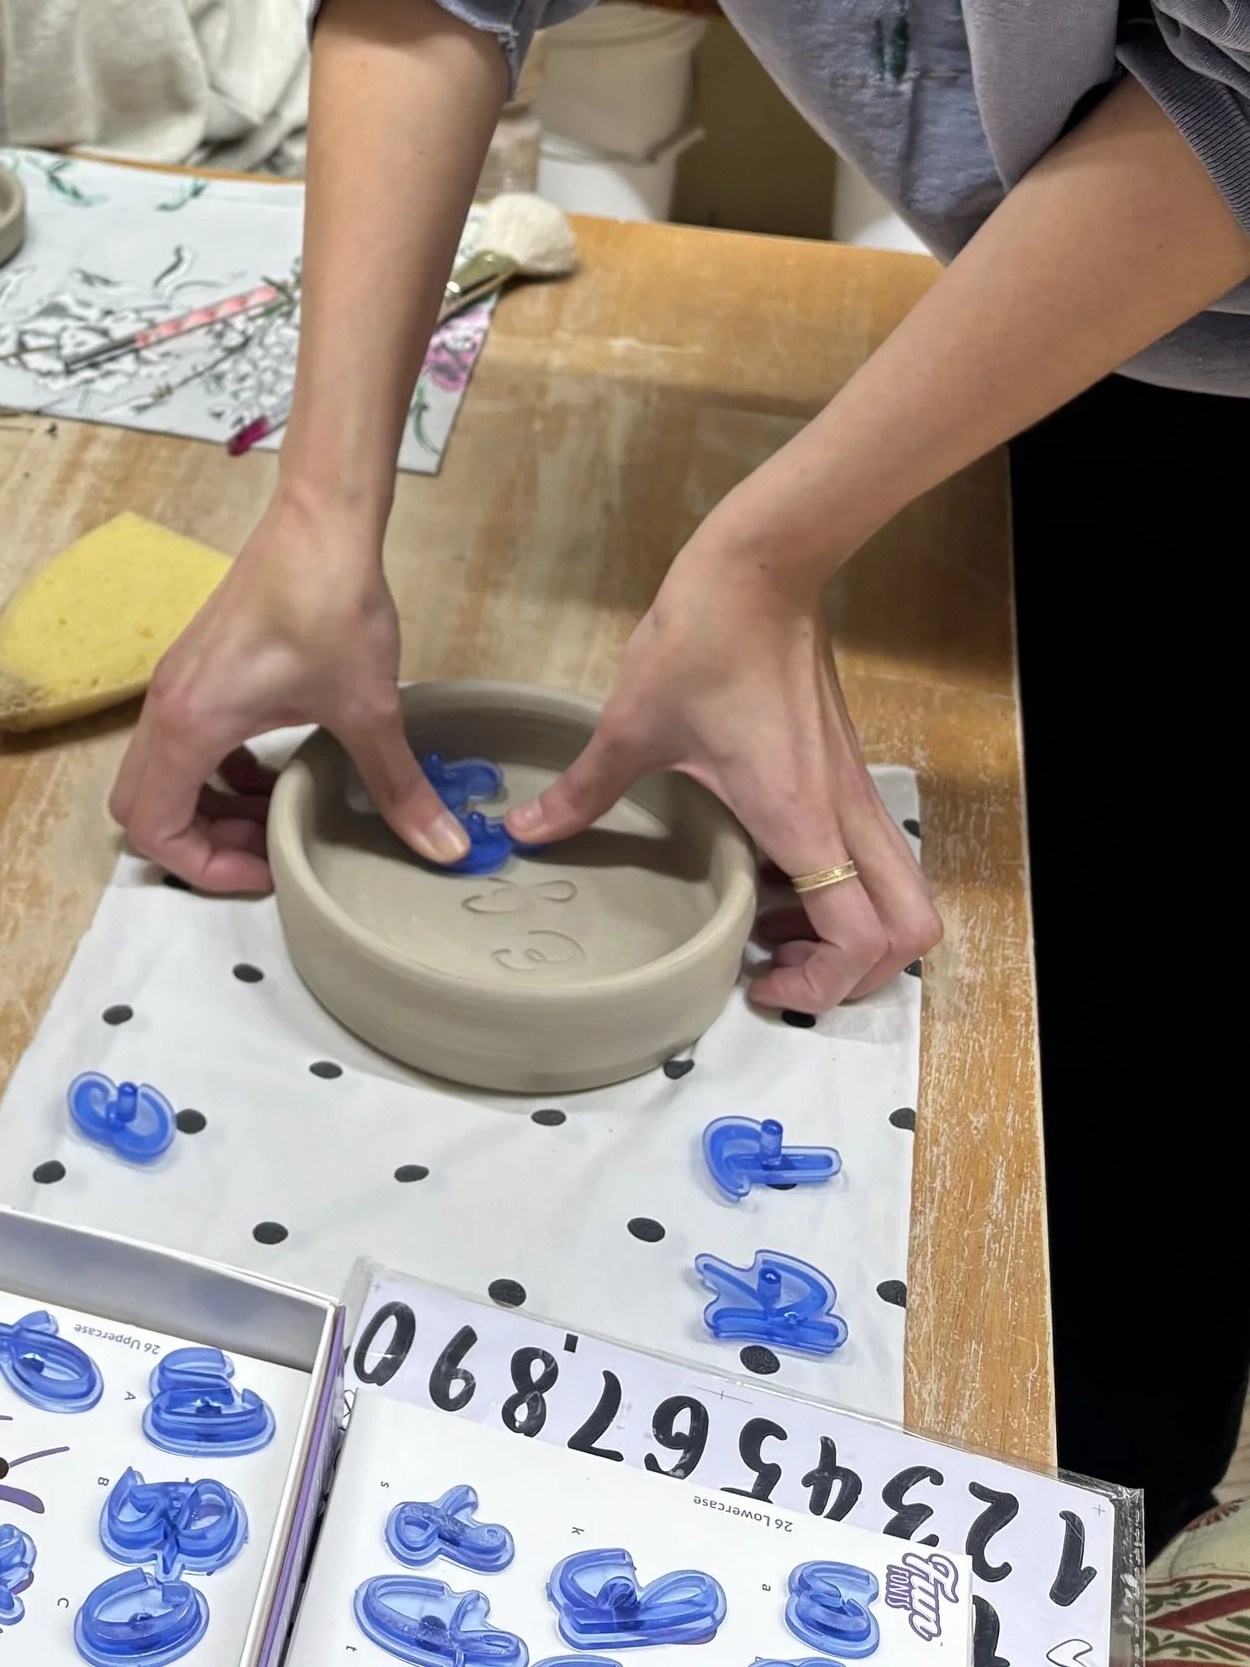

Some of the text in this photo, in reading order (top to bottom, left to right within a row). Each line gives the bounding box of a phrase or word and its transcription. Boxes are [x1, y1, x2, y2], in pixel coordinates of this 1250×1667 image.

[74, 1323, 161, 1355] 26 Uppercase
[124, 1391, 136, 1401] A
[97, 1477, 110, 1487] B
[693, 1495, 794, 1533] 26 Lowercase
[762, 1583, 771, 1592] a
[885, 1564, 912, 1611] FONTS
[902, 1552, 959, 1642] Fun
[57, 1596, 70, 1608] C
